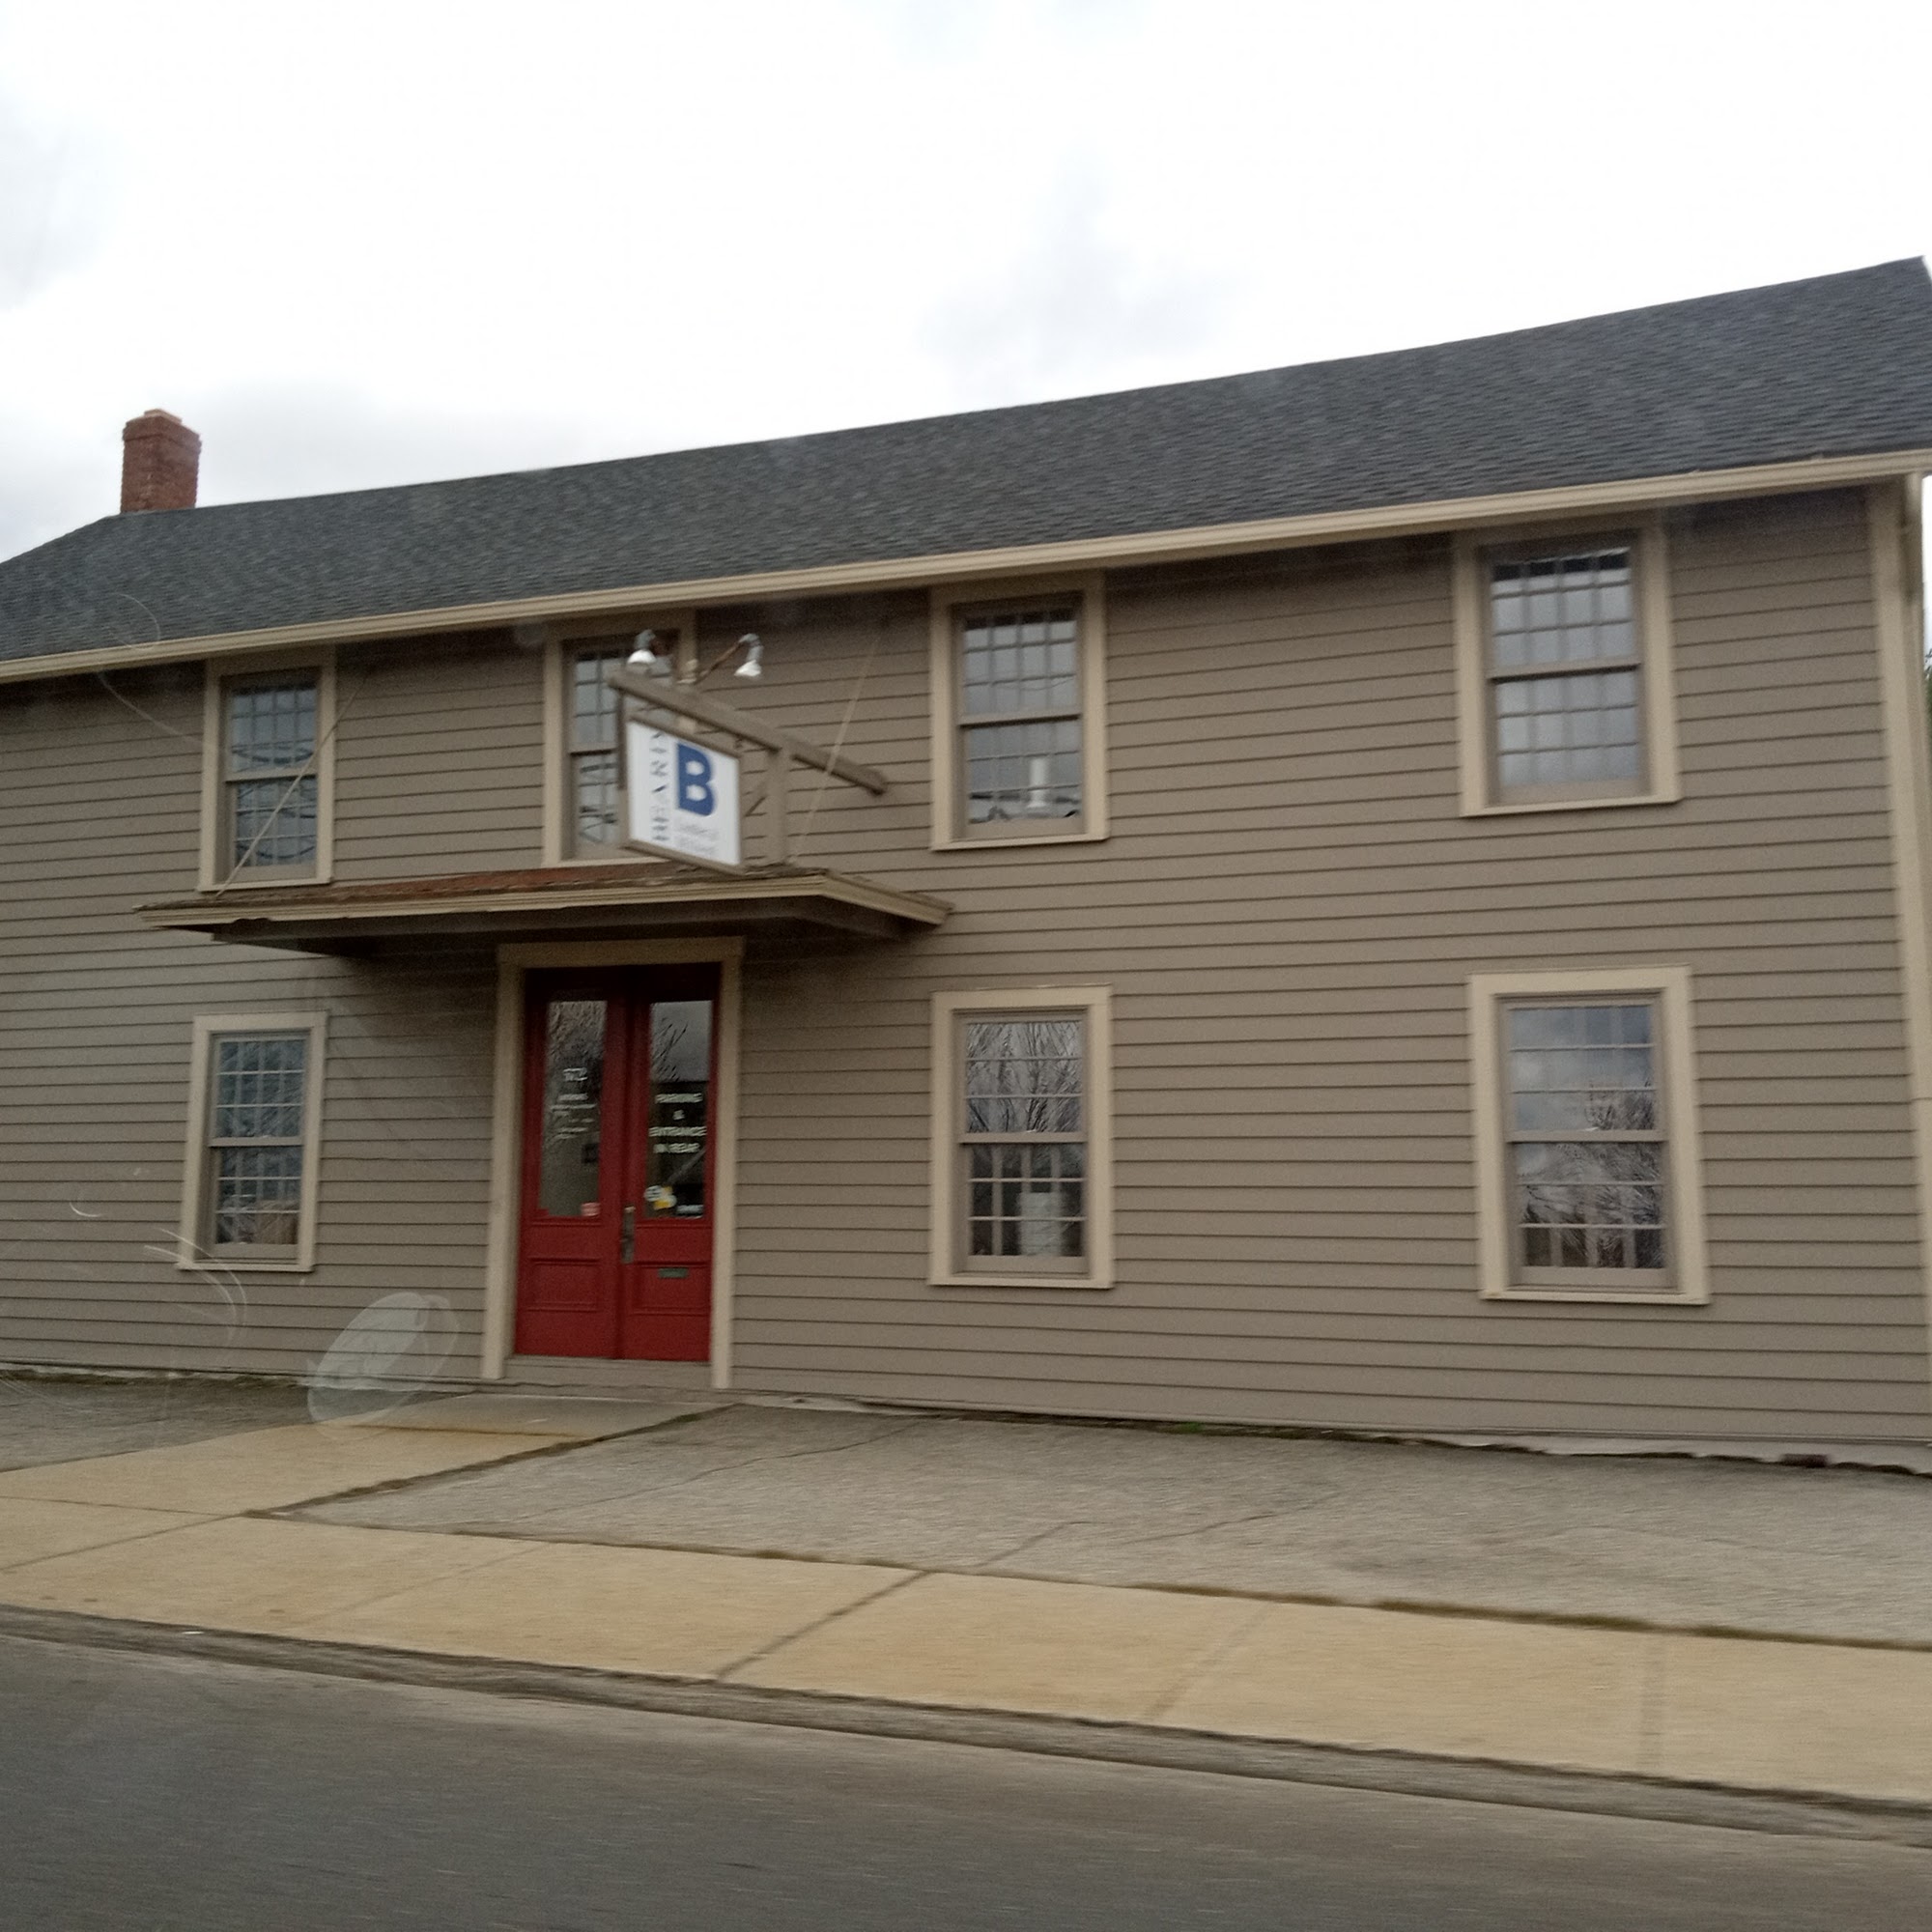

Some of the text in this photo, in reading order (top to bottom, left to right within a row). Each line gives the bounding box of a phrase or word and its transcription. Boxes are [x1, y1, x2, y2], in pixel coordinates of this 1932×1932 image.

[676, 742, 715, 816] B
[648, 1125, 708, 1137] ENTRANCE
[668, 1143, 700, 1153] REAR
